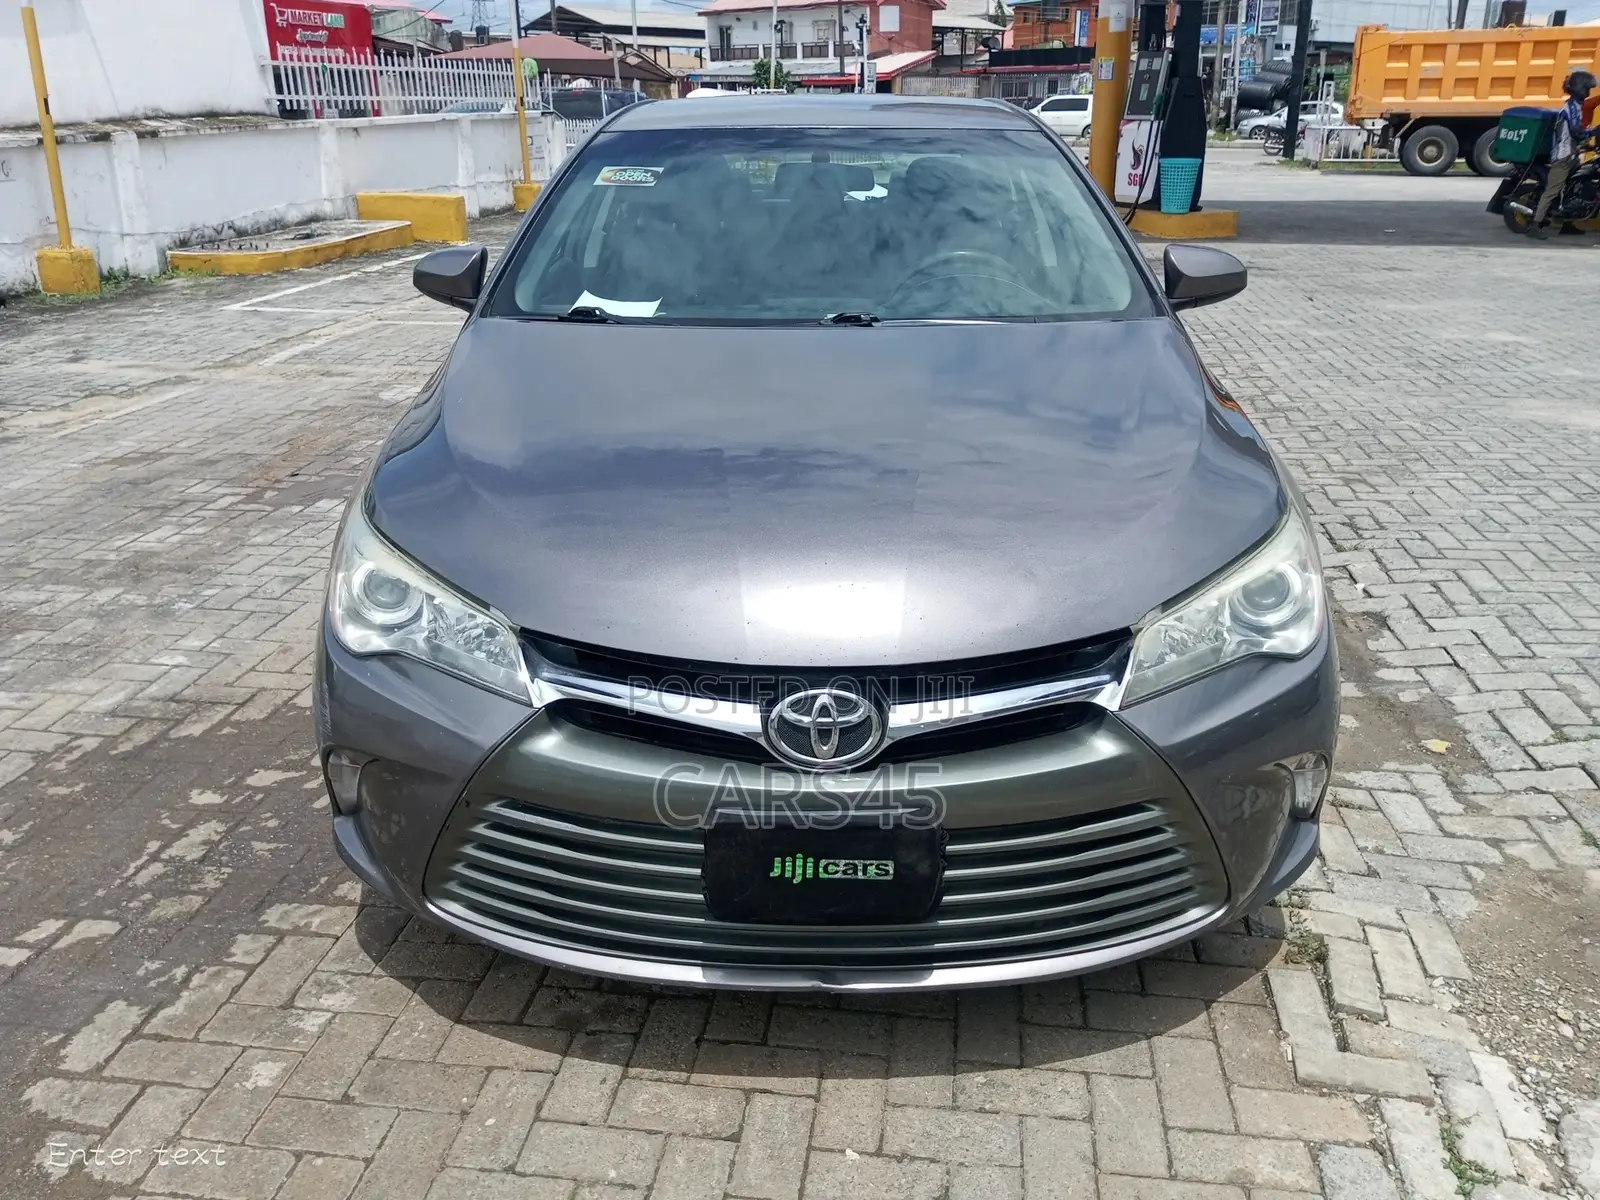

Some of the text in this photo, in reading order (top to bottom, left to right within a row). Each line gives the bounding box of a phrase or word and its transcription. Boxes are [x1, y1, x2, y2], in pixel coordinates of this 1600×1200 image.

[287, 9, 322, 26] MARKET
[1499, 128, 1528, 143] BOLT
[615, 171, 652, 179] OPEN
